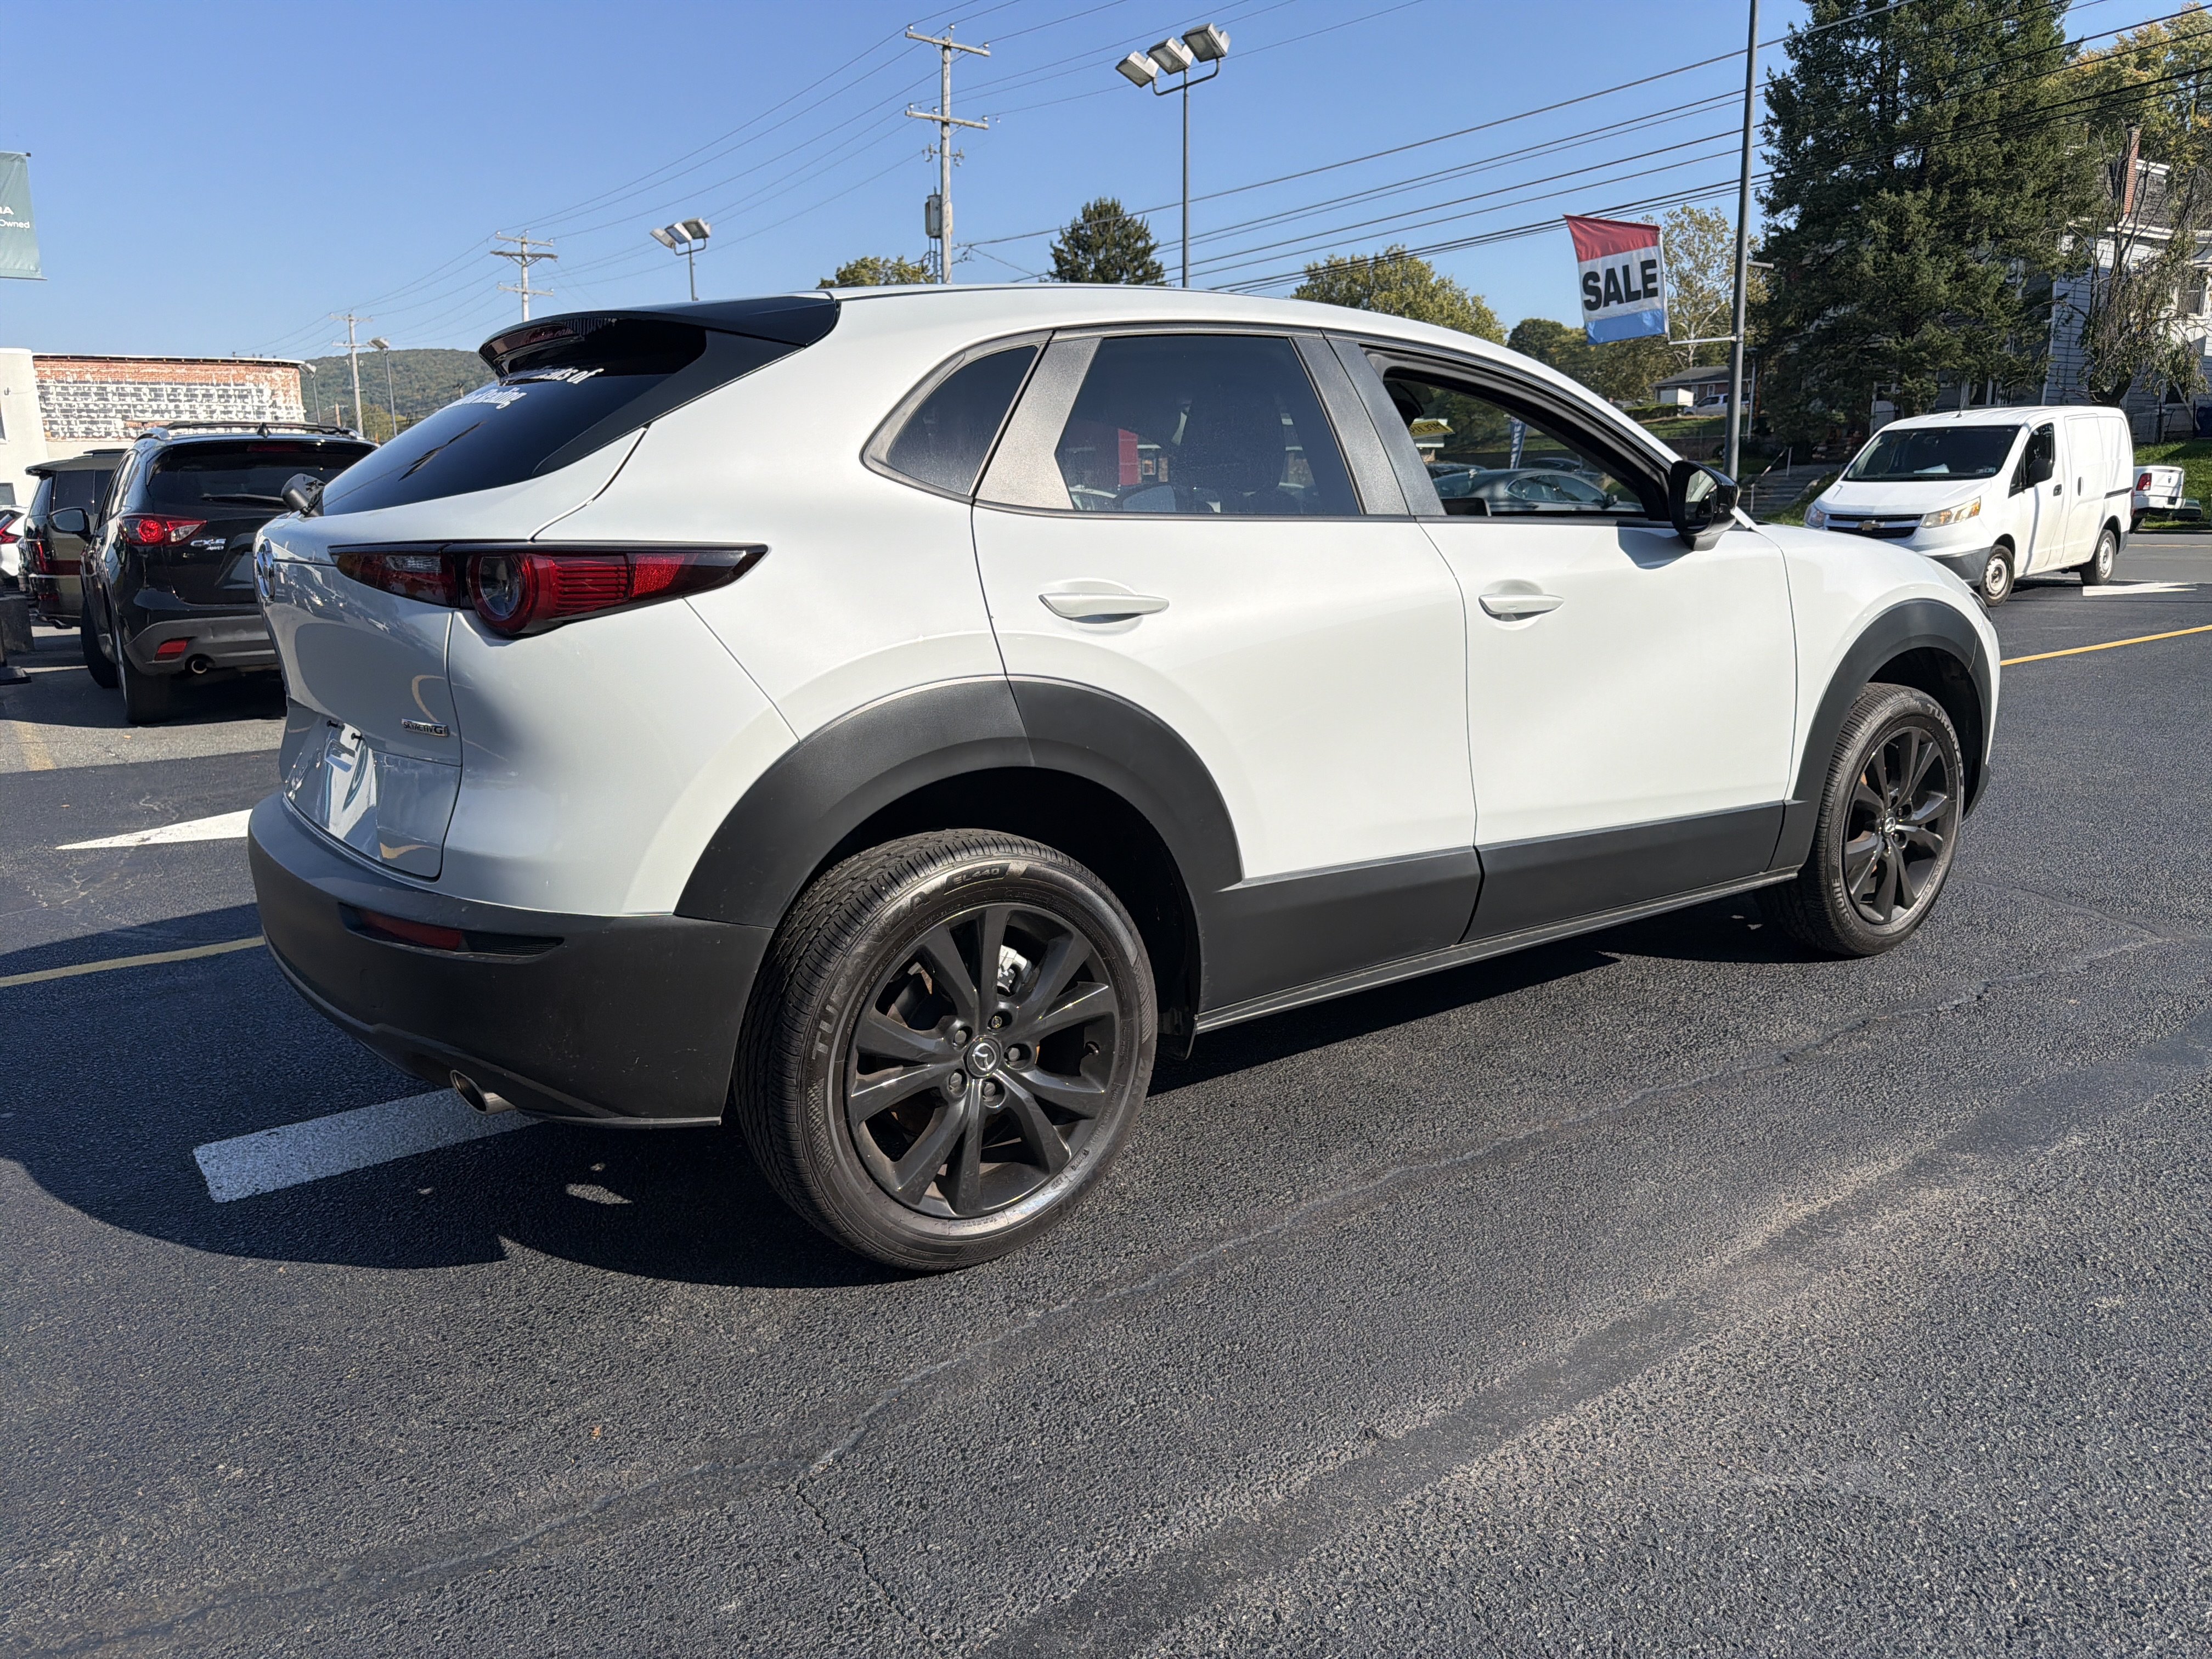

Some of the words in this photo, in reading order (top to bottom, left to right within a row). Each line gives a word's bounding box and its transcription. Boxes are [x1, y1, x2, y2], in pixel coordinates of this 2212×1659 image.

[1582, 259, 1658, 311] SALE
[190, 538, 227, 546] CX-5
[1927, 703, 1963, 778] TURANZA
[953, 868, 1000, 884] EL440
